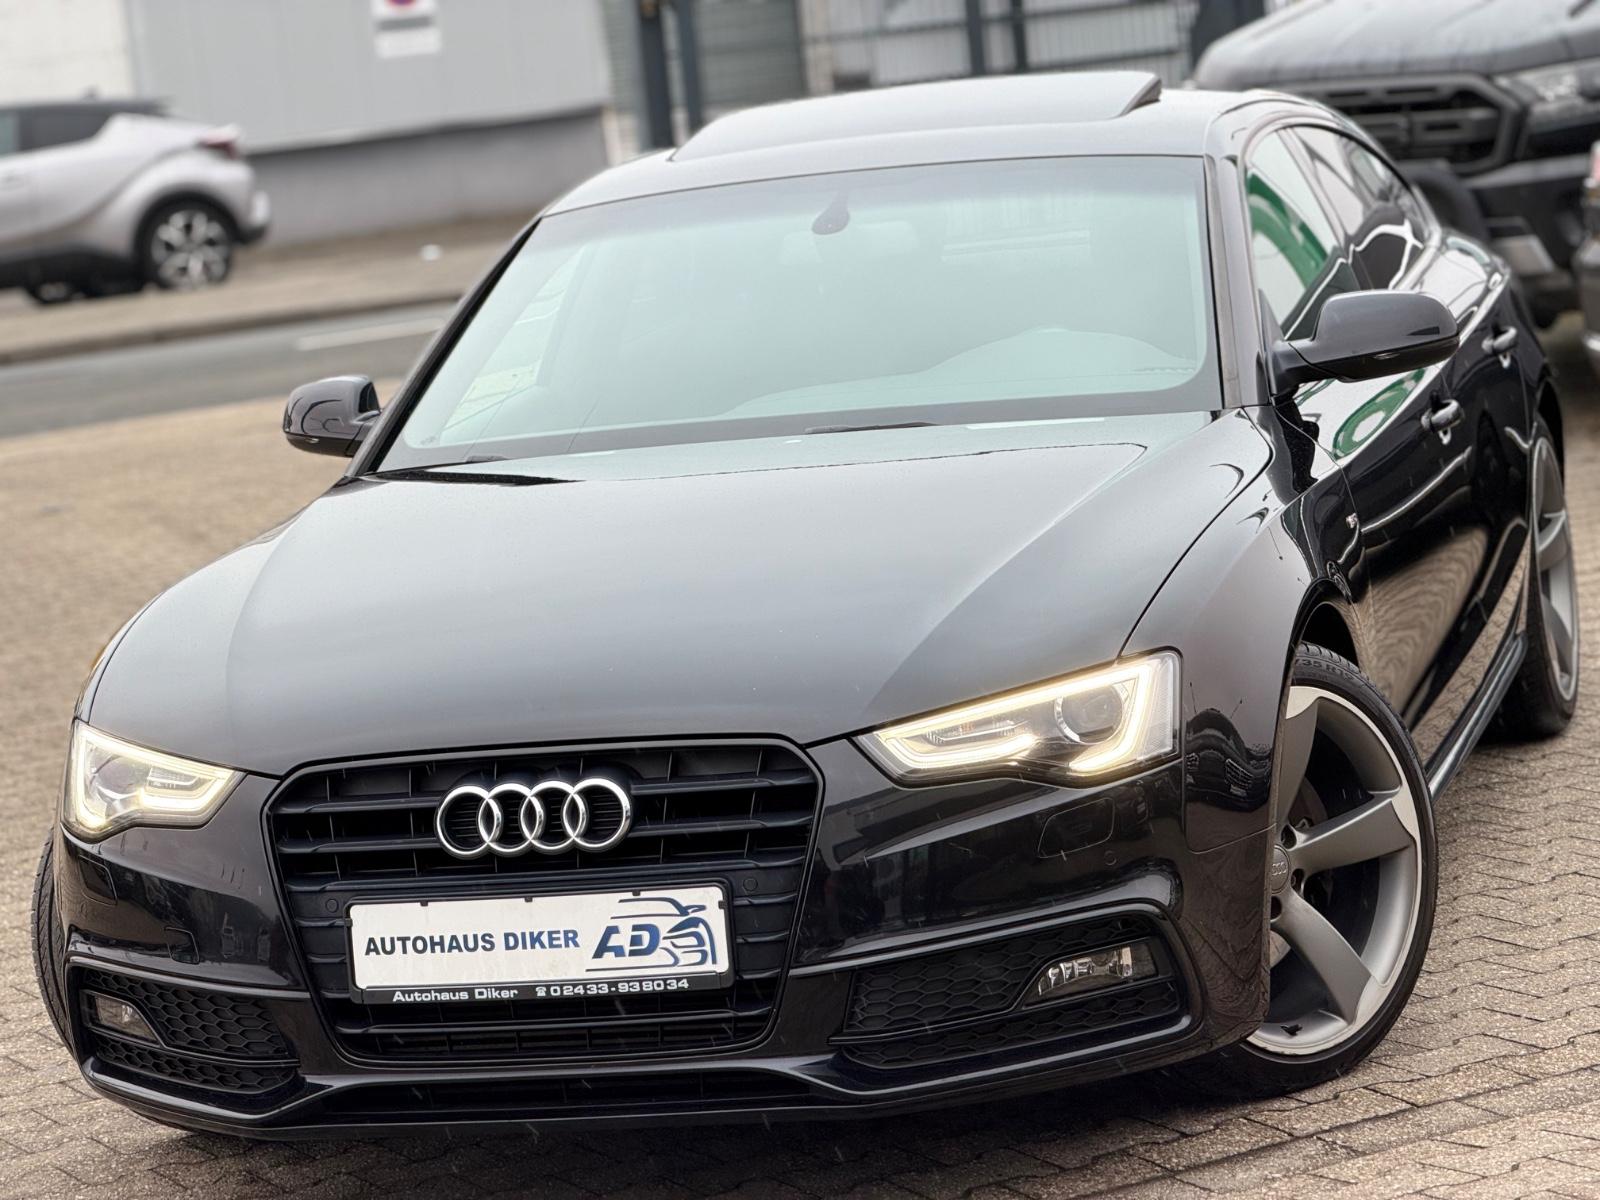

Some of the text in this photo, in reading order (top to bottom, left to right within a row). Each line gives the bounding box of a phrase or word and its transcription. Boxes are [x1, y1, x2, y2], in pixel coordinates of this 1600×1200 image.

[365, 929, 580, 956] AUTOHAUS DIKER
[592, 923, 661, 959] AD
[392, 979, 689, 1002] Autohaus Diker 02433-938034
